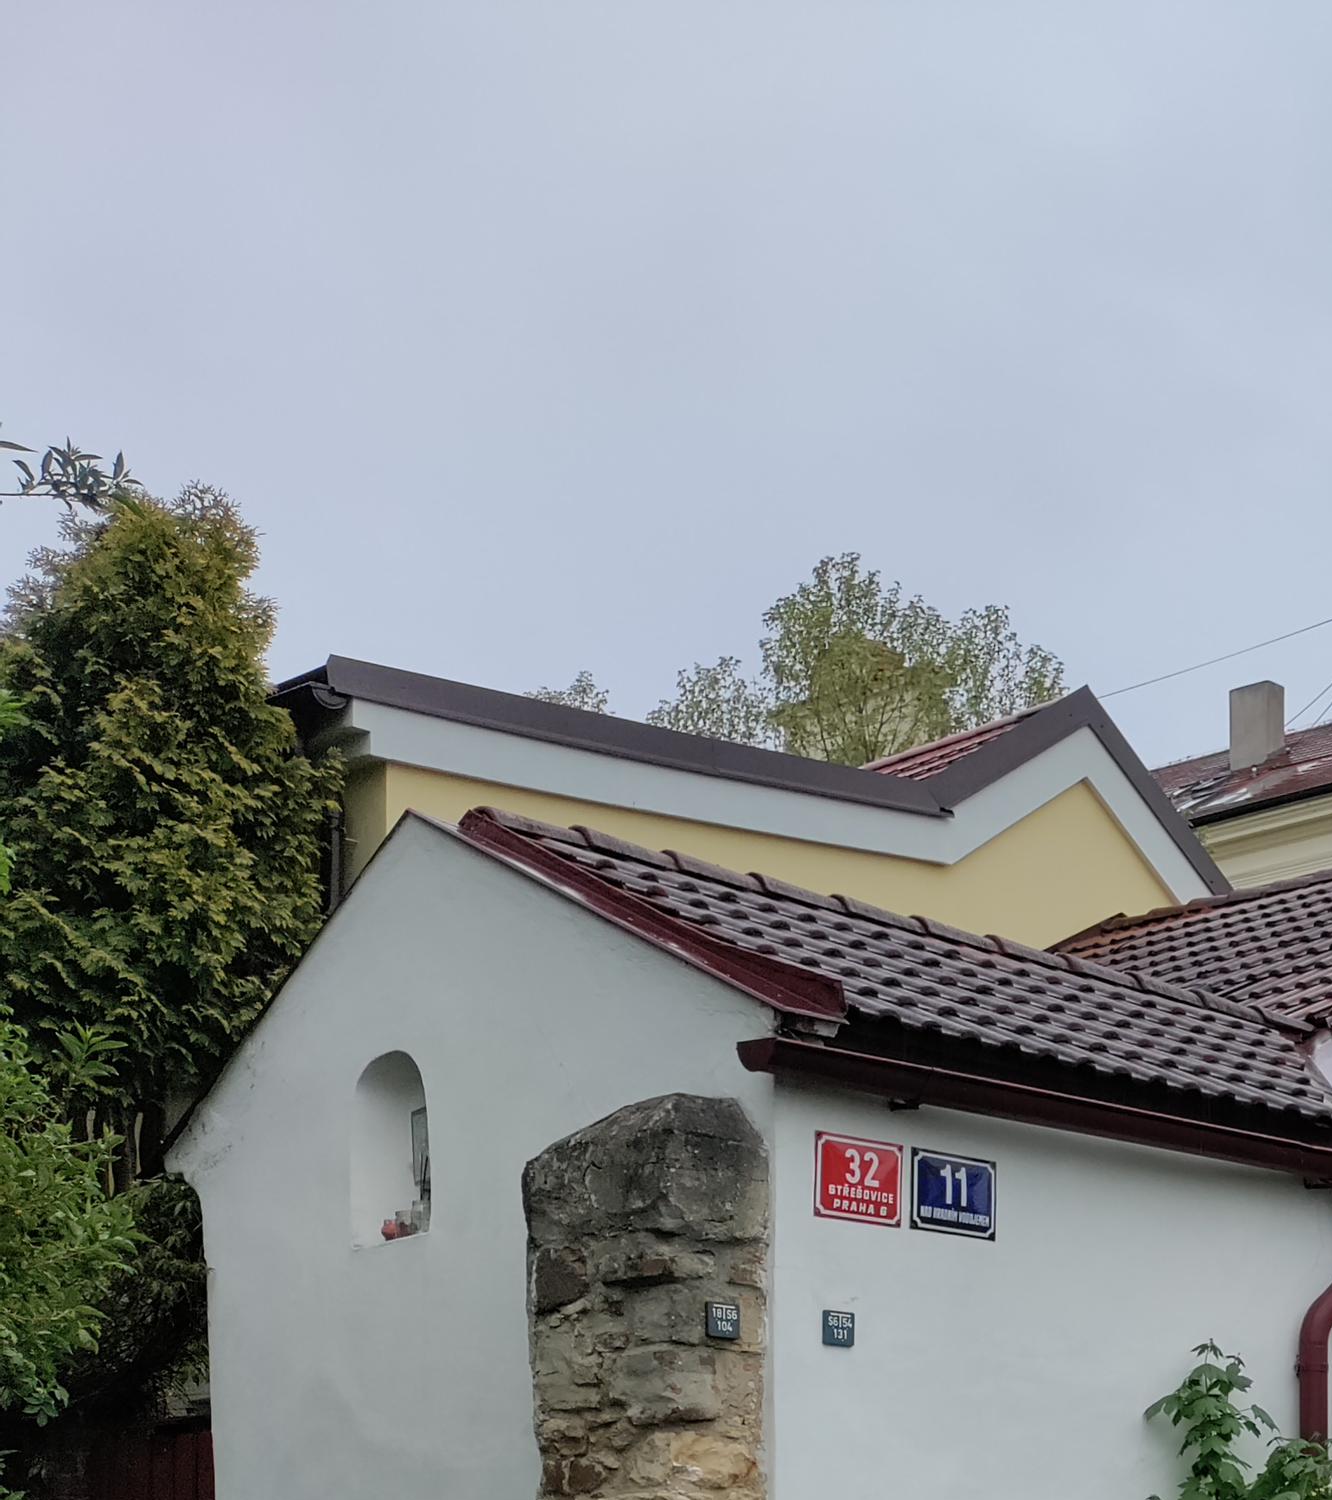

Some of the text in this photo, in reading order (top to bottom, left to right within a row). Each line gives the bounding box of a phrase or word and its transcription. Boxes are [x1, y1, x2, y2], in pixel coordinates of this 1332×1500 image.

[845, 1148, 880, 1188] 32
[828, 1184, 894, 1204] STŘEŠOVICE
[940, 1164, 967, 1207] 11
[833, 1198, 888, 1217] PRAHA 6
[717, 1320, 733, 1332] 104
[833, 1328, 848, 1340] 131
